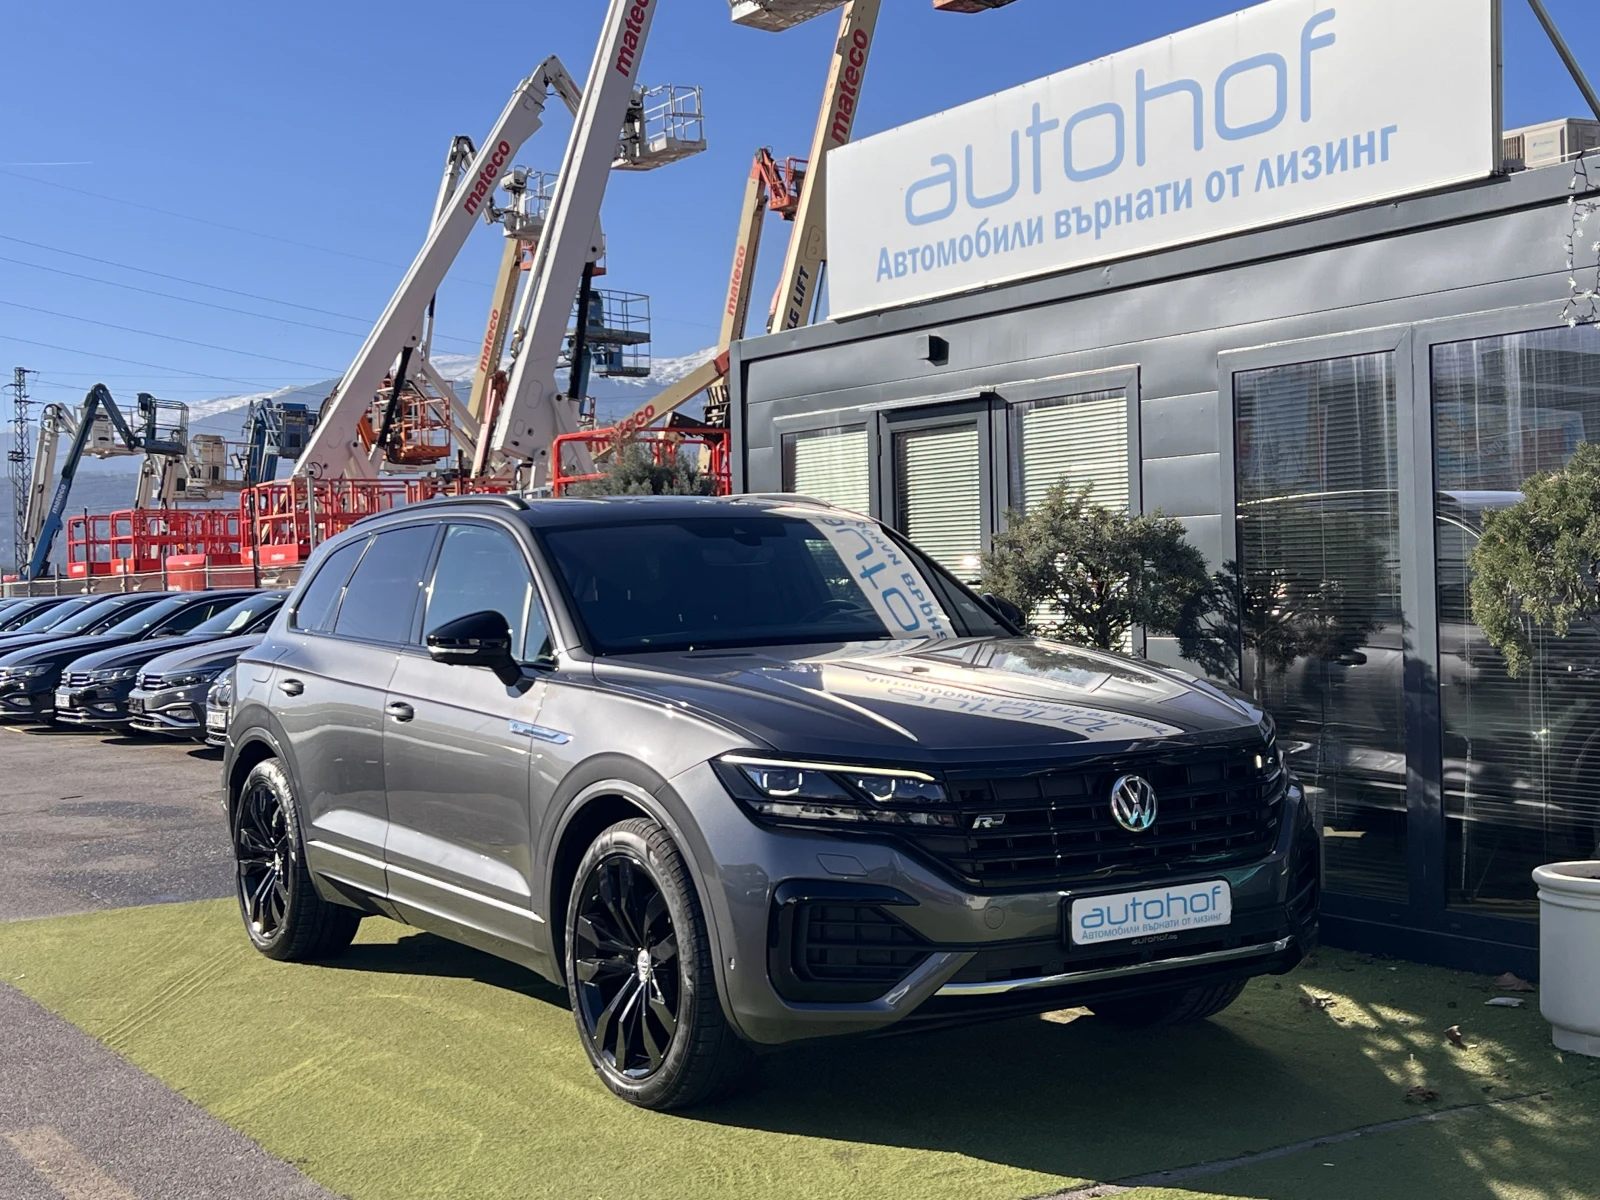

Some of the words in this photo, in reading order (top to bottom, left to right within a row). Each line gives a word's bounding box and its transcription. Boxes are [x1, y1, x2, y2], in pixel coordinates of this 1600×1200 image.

[831, 28, 868, 145] mateco
[905, 8, 1336, 226] autohof
[464, 140, 511, 216] mateco
[877, 217, 1044, 283] Автомобили
[1054, 177, 1193, 240] върнати
[1205, 162, 1245, 204] от
[1254, 124, 1398, 193] лизинг
[727, 245, 746, 317] mateco
[793, 265, 809, 308] LIFT
[480, 308, 499, 373] mateco
[787, 307, 801, 330] LG
[52, 483, 67, 514] mateco
[1081, 885, 1222, 929] autohof
[1081, 924, 1140, 941] Автомобили
[1142, 919, 1180, 934] върнати
[1181, 916, 1191, 927] от
[1193, 912, 1222, 925] лизинг
